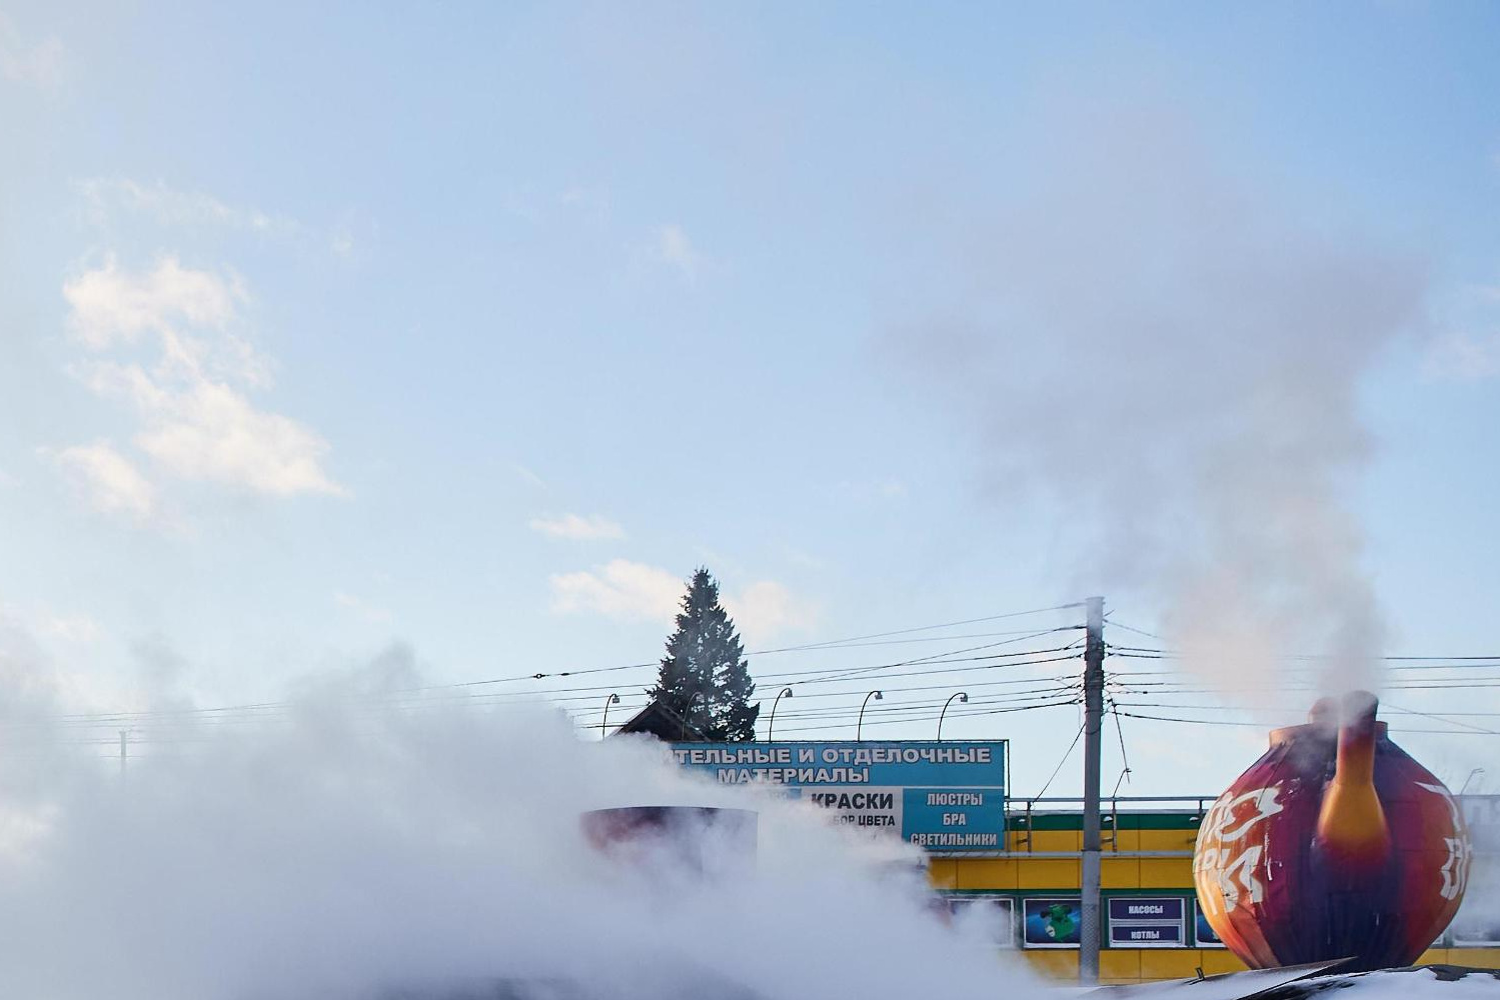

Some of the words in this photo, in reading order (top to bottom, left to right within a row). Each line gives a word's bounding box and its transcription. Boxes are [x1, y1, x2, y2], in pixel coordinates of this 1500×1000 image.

[664, 748, 791, 764] ИТЕЛЬНЫЕ
[798, 748, 815, 763] И
[822, 748, 991, 766] ОТДЕЛОЧНЫЕ
[717, 768, 869, 784] МАТЕРИАЛЫ
[811, 793, 894, 810] КРАСКИ
[926, 793, 983, 806] ЛЮСТРЫ
[830, 815, 855, 826] БОР
[858, 815, 895, 827] ЦВЕТА
[942, 813, 966, 826] БРА
[910, 833, 997, 846] СВЕТИЛЬНИКИ
[1128, 905, 1163, 914] НАСОСЫ
[1130, 930, 1160, 939] КОТЛЫ
